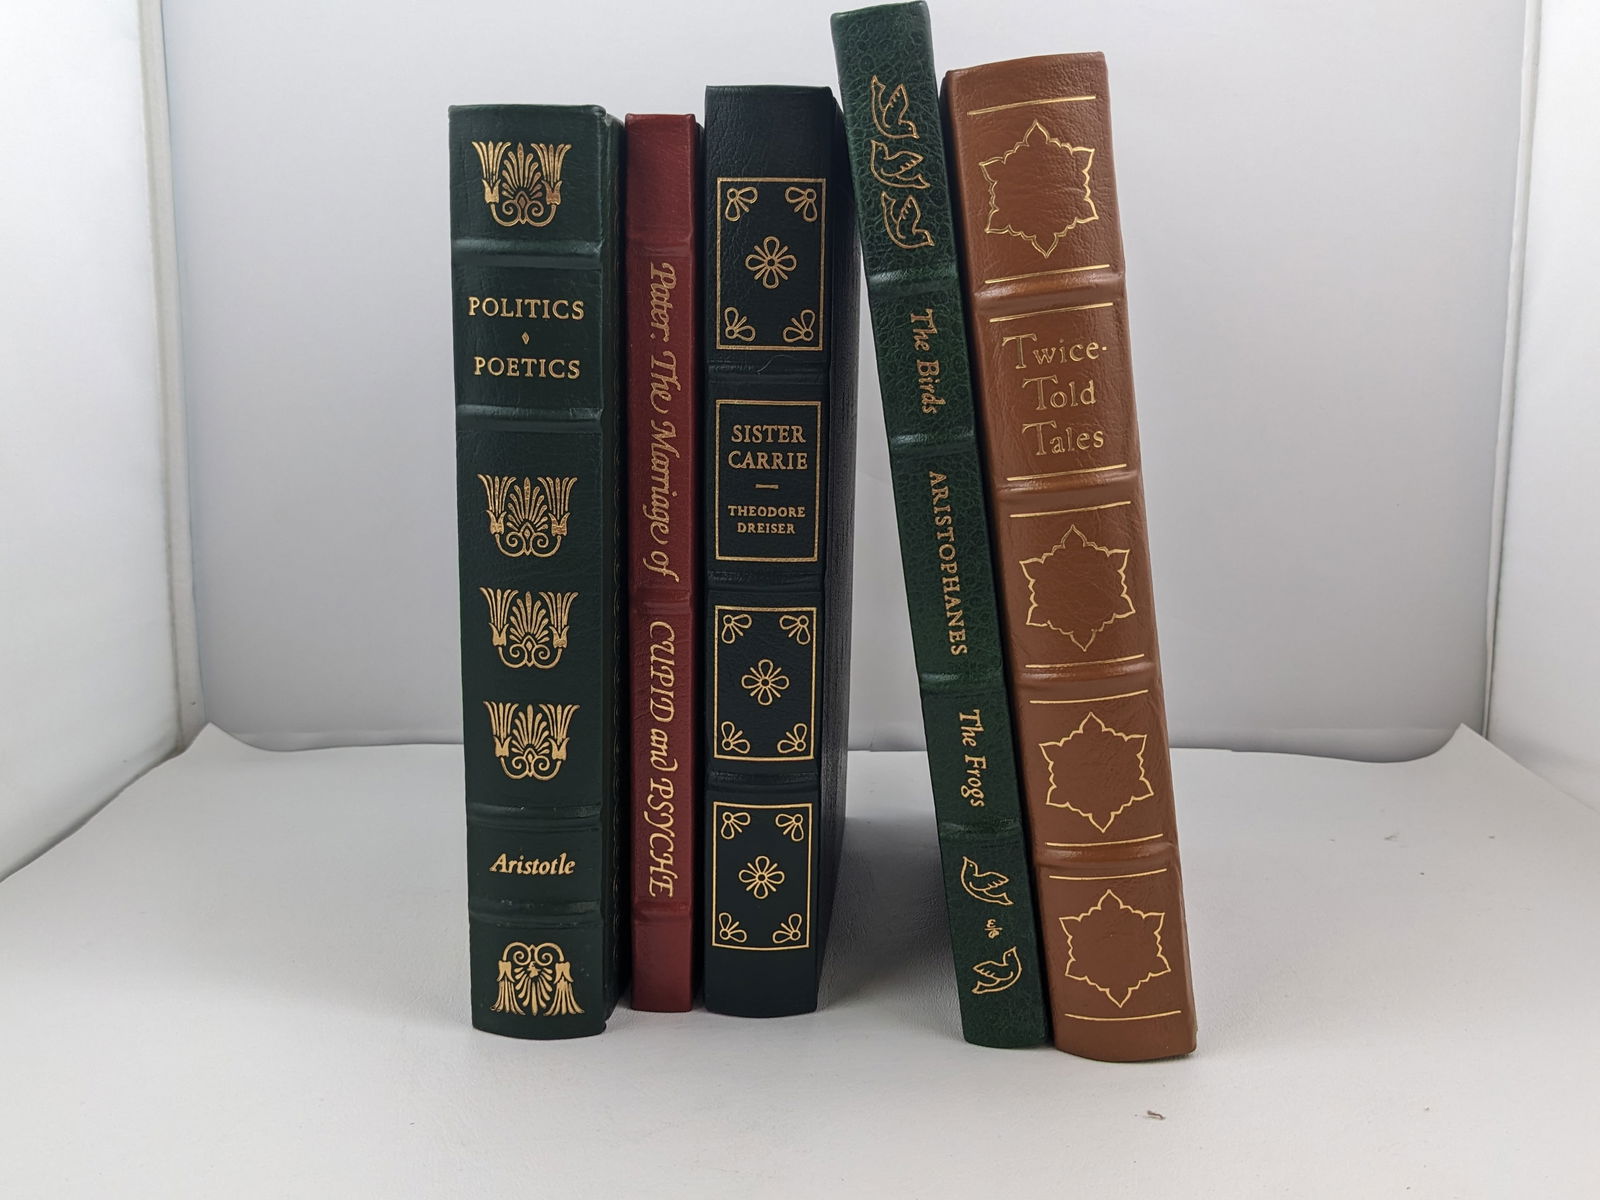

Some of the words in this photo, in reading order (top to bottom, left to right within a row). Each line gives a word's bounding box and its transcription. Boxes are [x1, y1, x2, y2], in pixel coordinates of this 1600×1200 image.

[468, 296, 585, 321] POLITICS
[910, 308, 938, 351] The
[473, 356, 580, 380] POETICS
[1001, 332, 1108, 370] Twice-
[650, 350, 682, 415] The
[916, 359, 947, 415] Birds
[1021, 374, 1097, 411] Told
[731, 424, 807, 444] SISTER
[1021, 419, 1104, 456] Tales
[727, 450, 808, 470] CARRIE
[642, 419, 681, 545] Marriage
[727, 505, 806, 518] THEODORE
[737, 522, 796, 535] DREISER
[642, 550, 680, 583] of
[928, 470, 968, 656] ARISTOPHANES
[649, 621, 675, 723] CUPID
[959, 709, 985, 747] The
[649, 728, 679, 772] and
[960, 754, 987, 807] Frogs
[643, 777, 679, 898] PSYCHE
[489, 852, 576, 876] Aristotle
